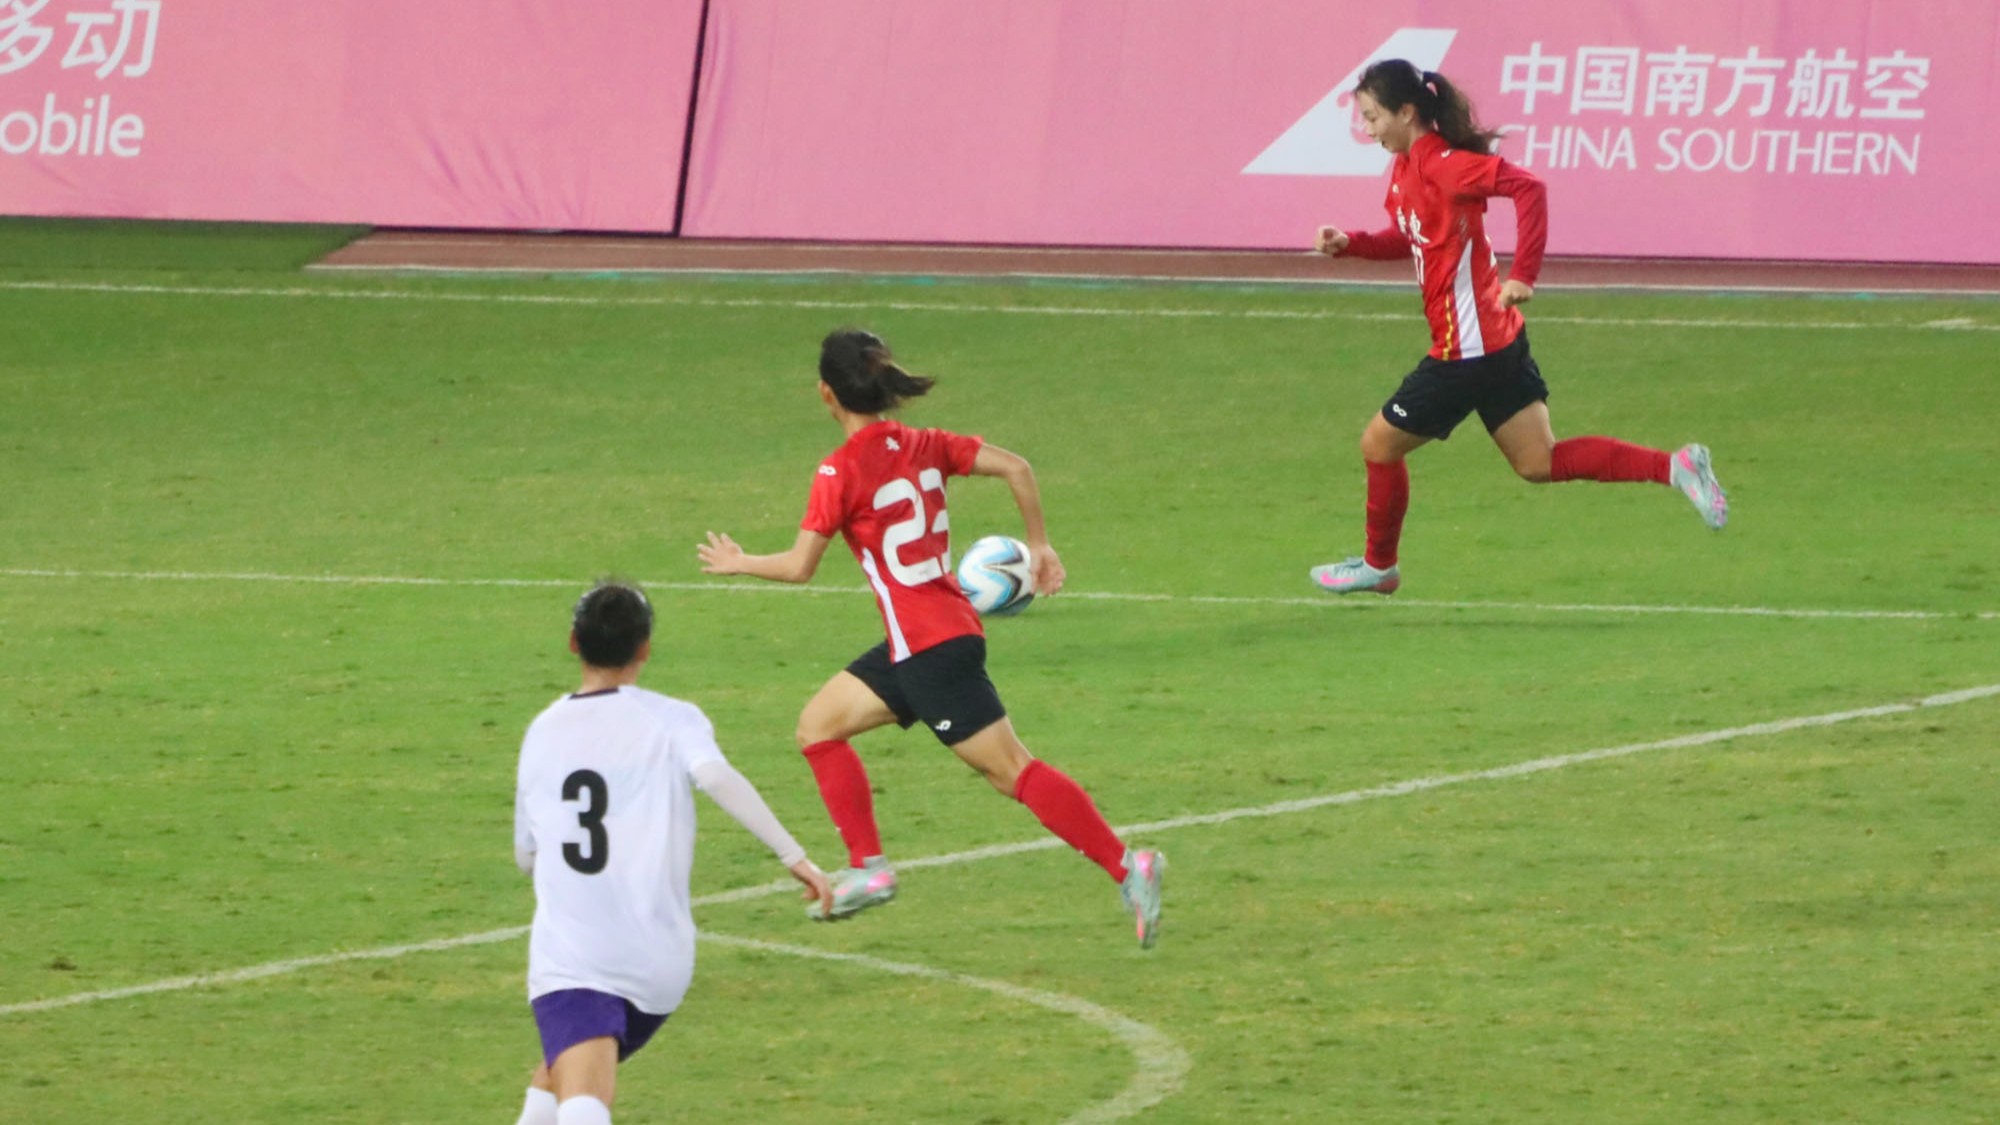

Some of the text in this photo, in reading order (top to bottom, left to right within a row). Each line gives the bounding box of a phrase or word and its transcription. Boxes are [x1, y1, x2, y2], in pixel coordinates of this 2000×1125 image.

[1499, 41, 1931, 119] 中国南方航空
[0, 92, 145, 156] obile
[1488, 123, 1921, 175] CHINA SOUTHERN
[561, 769, 609, 875] 3
